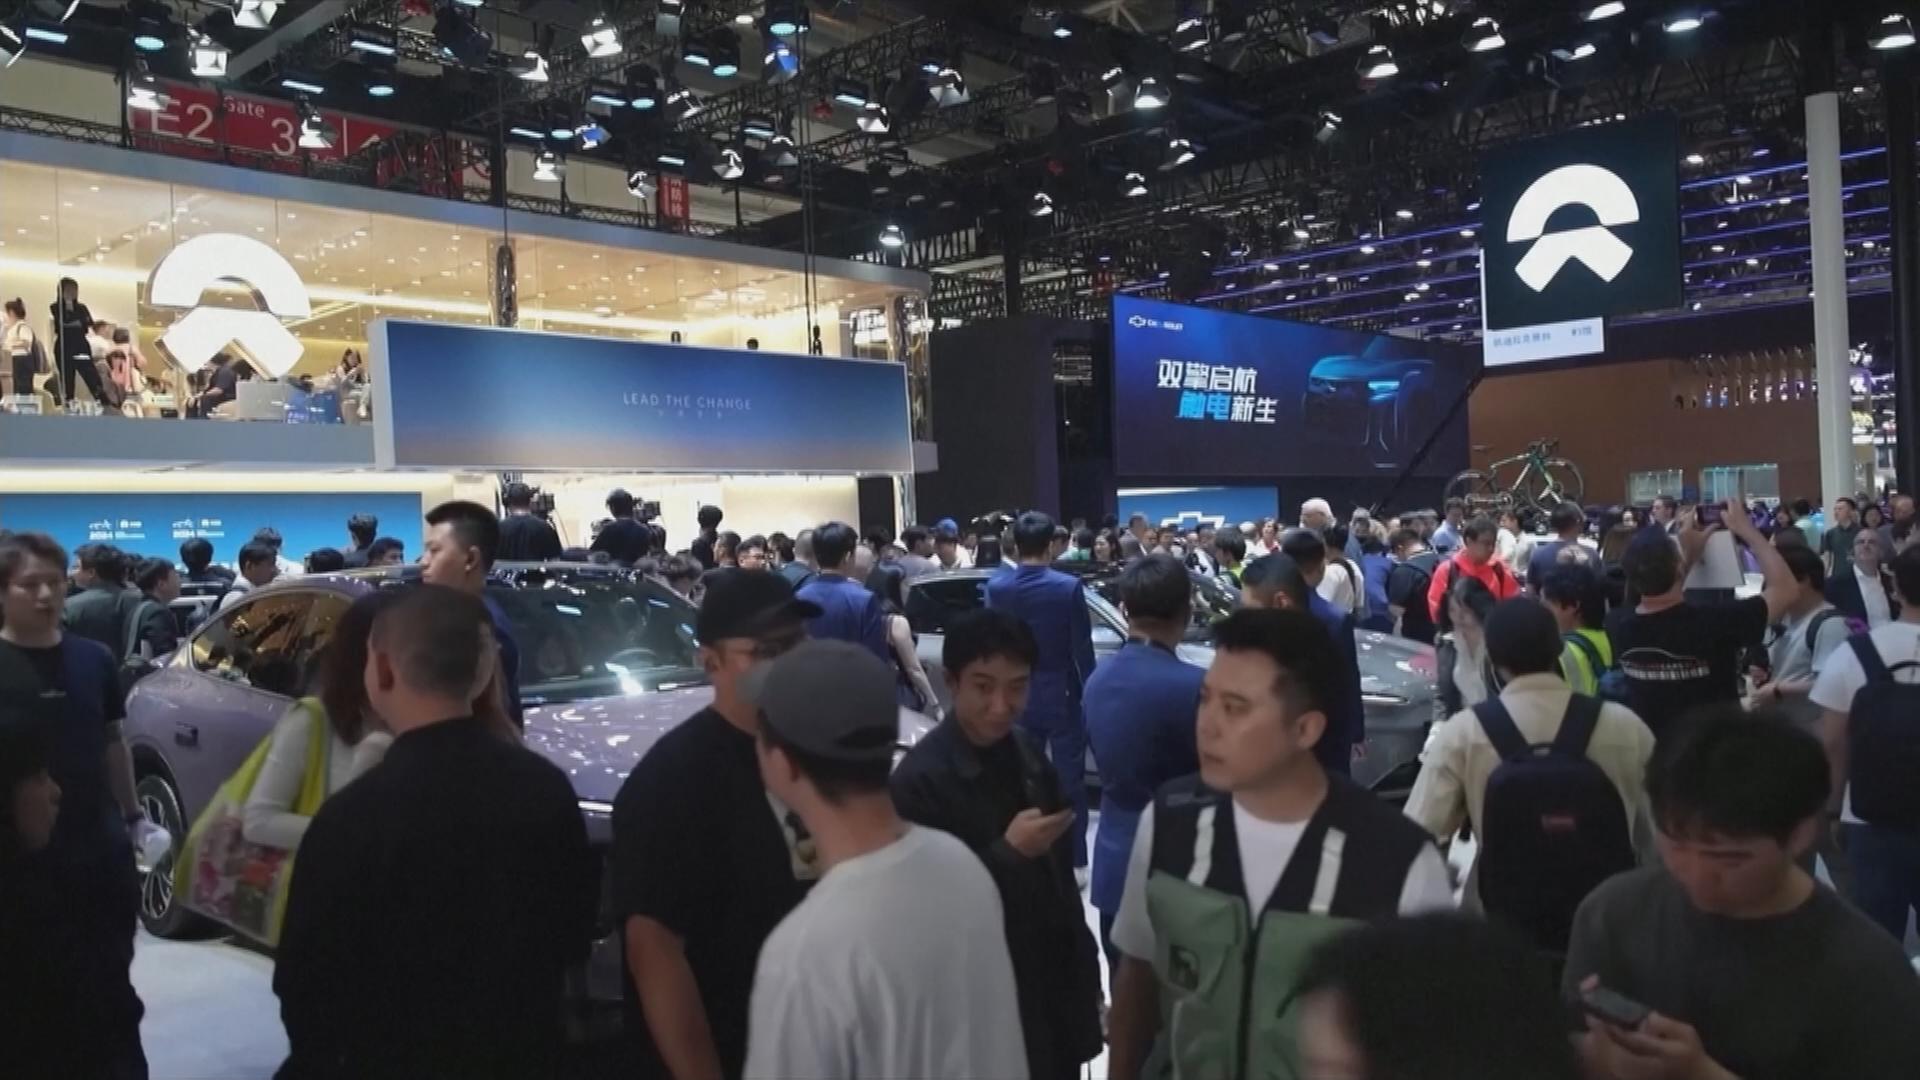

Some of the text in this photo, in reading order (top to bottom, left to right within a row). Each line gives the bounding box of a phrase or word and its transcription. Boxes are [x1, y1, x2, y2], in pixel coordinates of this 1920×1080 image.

[223, 97, 265, 119] Gate
[1157, 359, 1257, 394] 双擎启航
[622, 391, 752, 410] LEAD THE CHANGE
